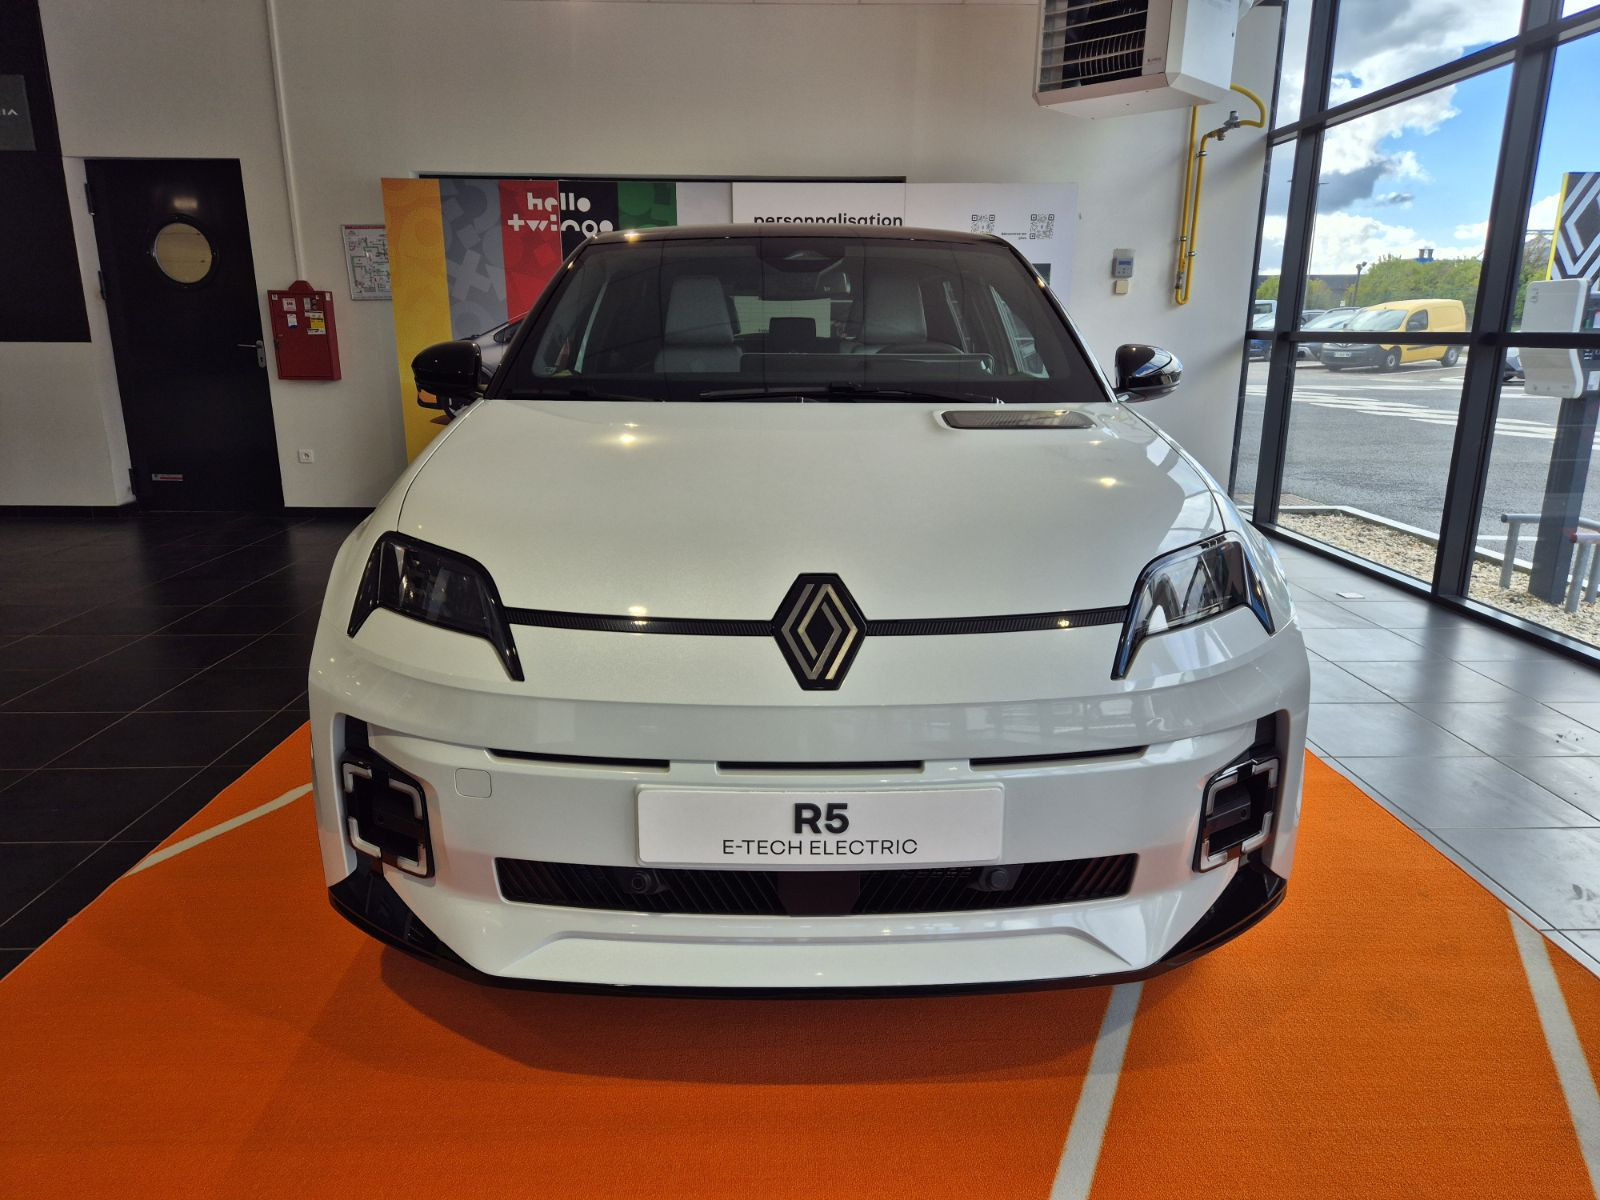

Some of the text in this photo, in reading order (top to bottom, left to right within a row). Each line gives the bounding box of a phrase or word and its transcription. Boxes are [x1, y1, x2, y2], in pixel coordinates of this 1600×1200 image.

[527, 192, 591, 212] hello
[754, 213, 903, 226] personnalisation
[794, 802, 849, 834] R5
[723, 839, 918, 856] E-TECH ELECTRIC
